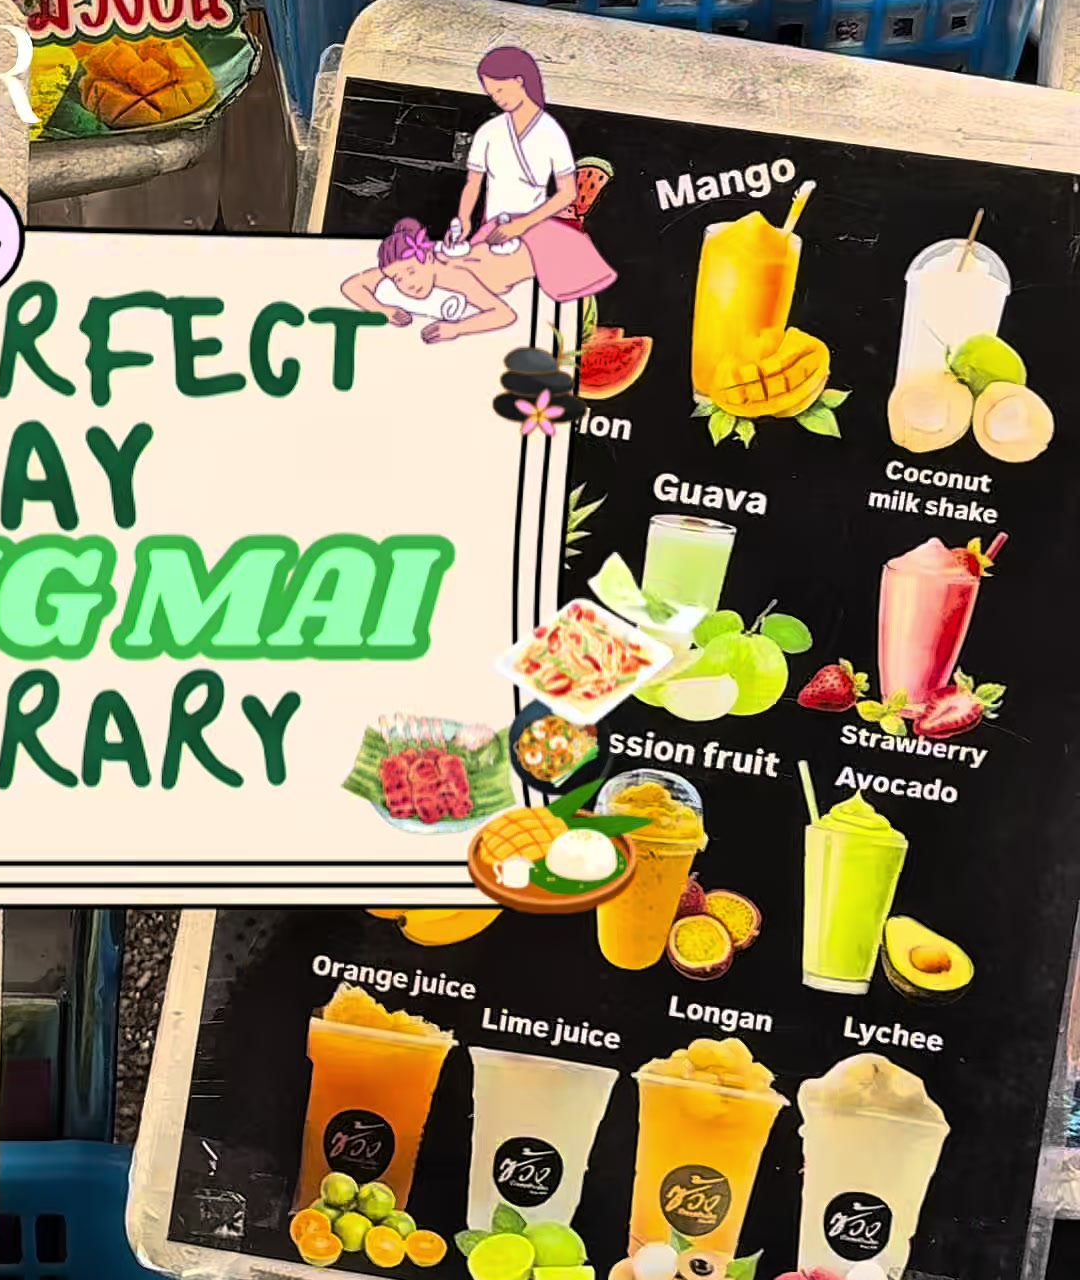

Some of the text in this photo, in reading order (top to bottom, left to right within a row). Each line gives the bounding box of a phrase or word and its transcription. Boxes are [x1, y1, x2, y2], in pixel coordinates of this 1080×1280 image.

[656, 156, 796, 211] Mango
[575, 407, 633, 441] lon
[653, 473, 768, 515] Guava
[885, 461, 992, 493] Coconut
[869, 489, 998, 523] milk shake
[703, 741, 780, 777] fruit
[840, 725, 988, 769] Strawberry
[835, 766, 958, 803] Avocado
[312, 955, 476, 998] Orange juice
[481, 1008, 621, 1048] Lime juice
[669, 996, 773, 1032] Longan
[843, 1017, 943, 1052] Lychee
